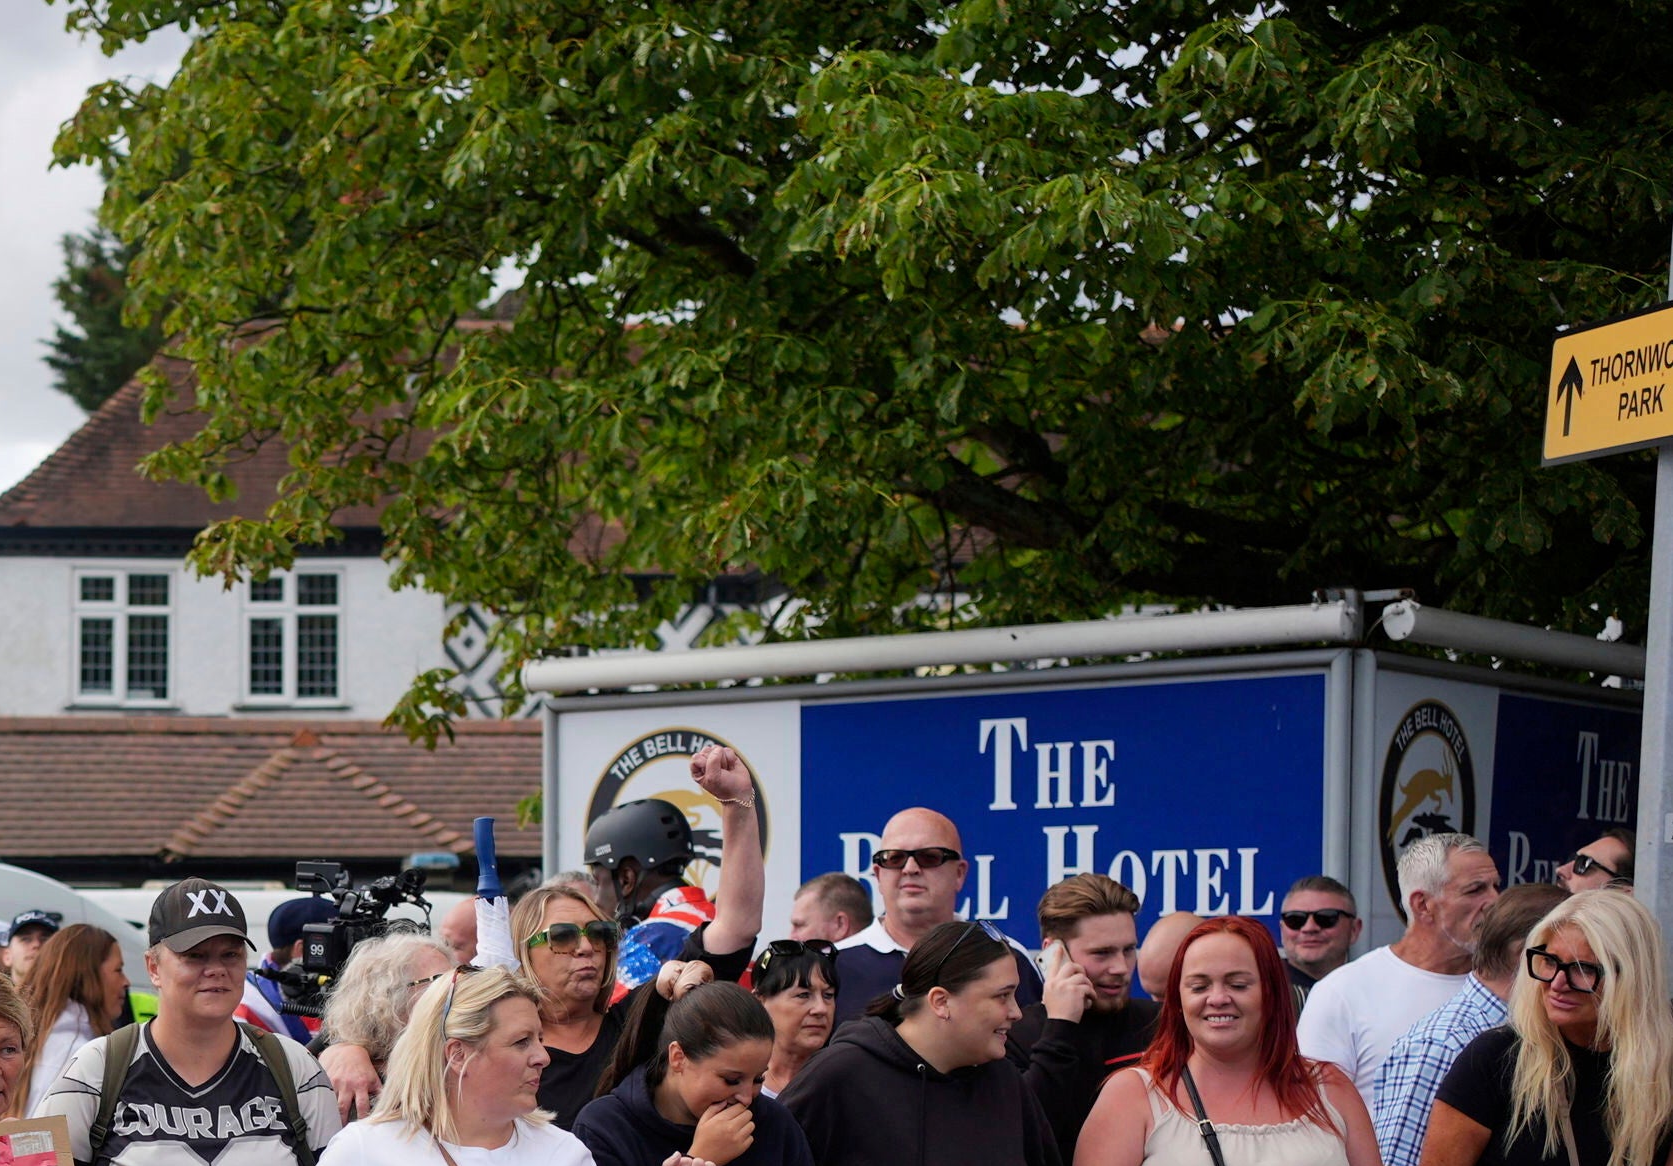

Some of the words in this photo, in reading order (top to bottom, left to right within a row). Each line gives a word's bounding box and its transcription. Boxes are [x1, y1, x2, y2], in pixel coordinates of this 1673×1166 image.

[1617, 384, 1665, 421] PARK
[610, 747, 644, 780] THE
[643, 734, 686, 760] BELL
[1396, 717, 1414, 752] THE
[1414, 707, 1438, 730] BELL
[1440, 712, 1465, 764] HOTEL
[979, 716, 1116, 811] THE
[1576, 730, 1631, 823] THE
[186, 889, 234, 918] XX
[310, 944, 325, 956] 99
[113, 1096, 287, 1138] COURAGE
